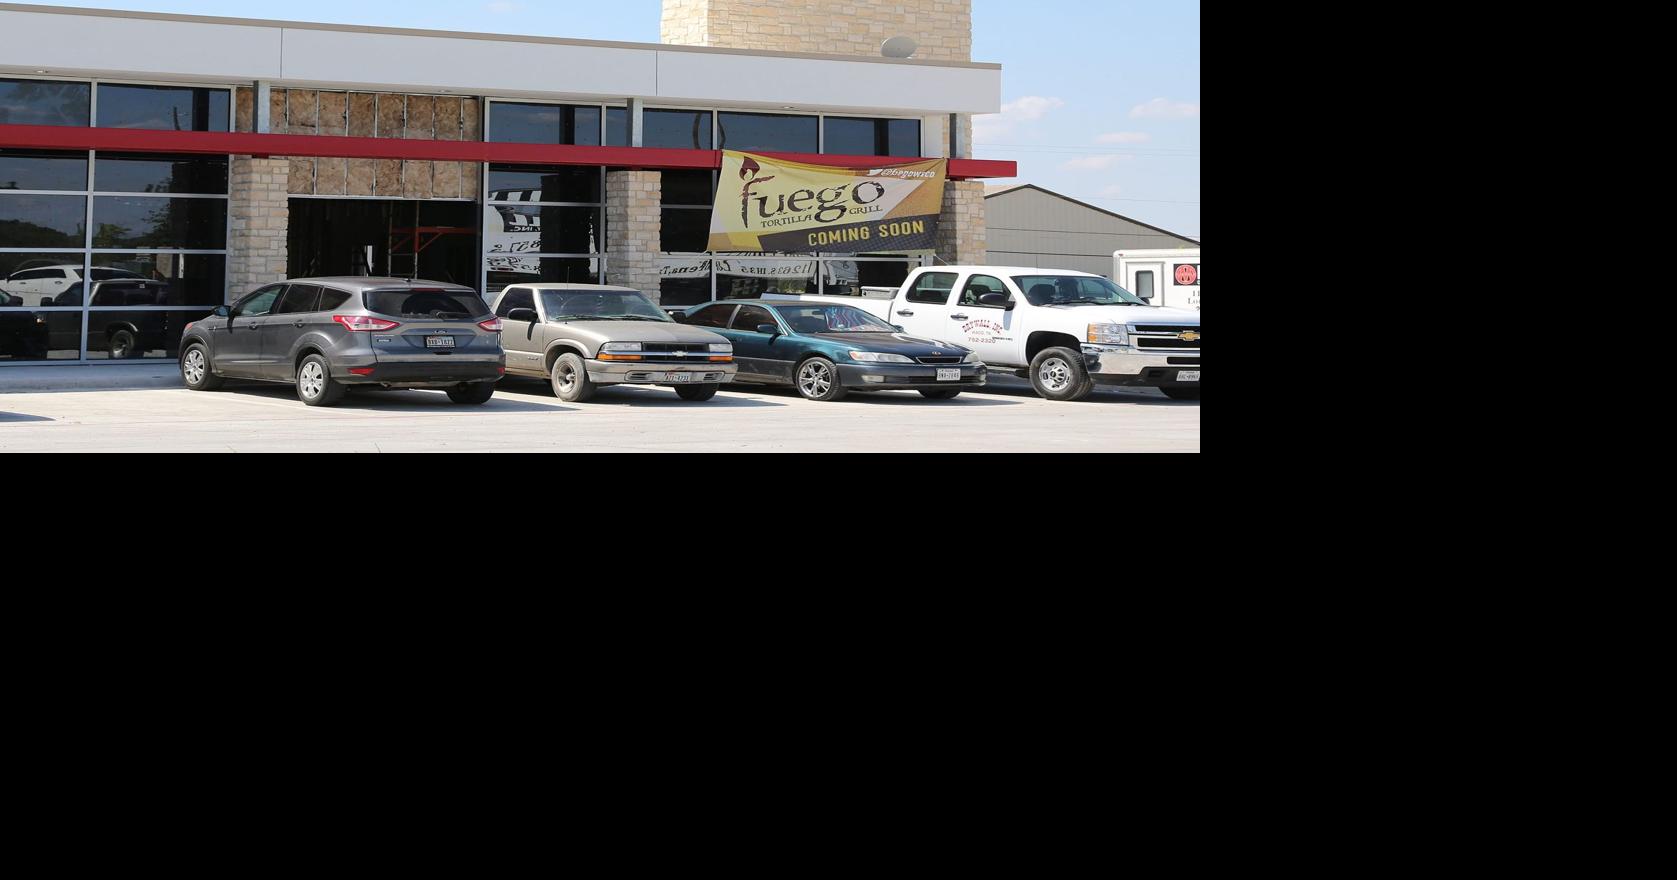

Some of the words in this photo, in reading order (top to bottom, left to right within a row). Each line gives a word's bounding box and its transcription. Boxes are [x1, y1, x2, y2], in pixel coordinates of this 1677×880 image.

[849, 204, 883, 216] GRILL
[760, 213, 812, 228] TORTILLA
[808, 224, 871, 246] COMING
[878, 220, 925, 238] SOON
